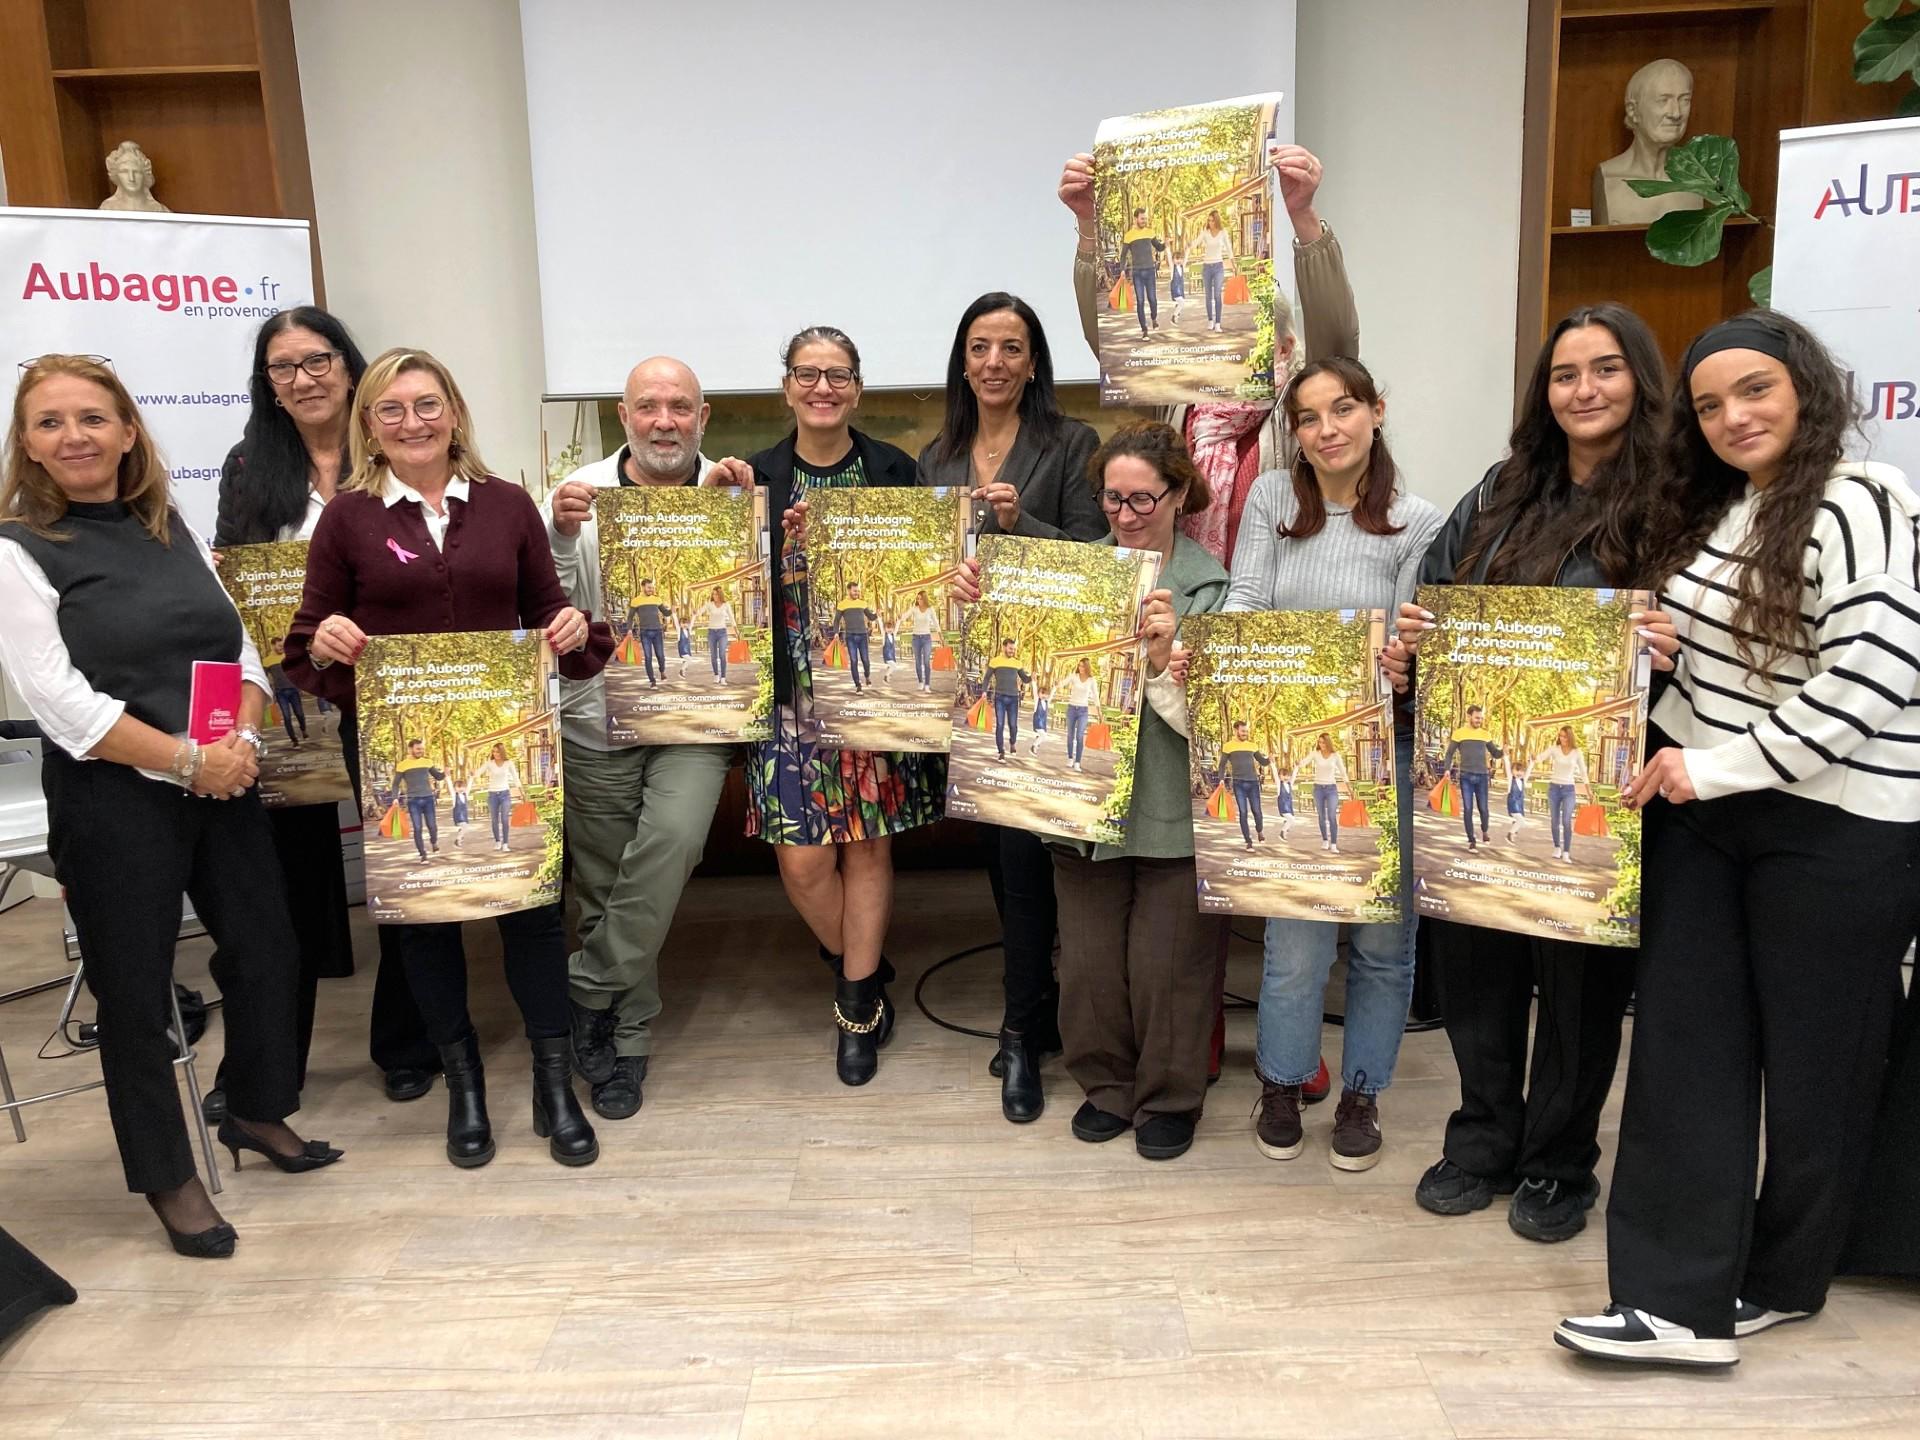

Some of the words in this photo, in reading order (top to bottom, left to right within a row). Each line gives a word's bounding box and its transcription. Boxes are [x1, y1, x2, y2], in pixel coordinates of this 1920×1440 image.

[1122, 148, 1132, 160] je
[1115, 160, 1145, 172] dans
[1147, 158, 1165, 169] ses
[1168, 152, 1229, 166] boutiques
[184, 305, 203, 317] en
[208, 306, 279, 320] provence
[1124, 358, 1143, 367] c'est
[1221, 353, 1241, 361] vivre
[615, 513, 654, 523] J'aime
[823, 515, 860, 525] J'aime
[628, 526, 638, 537] je
[641, 527, 704, 535] consomme
[835, 529, 844, 539] je
[847, 529, 908, 537] consomme
[623, 538, 652, 547] dans
[674, 538, 730, 548] boutiques
[830, 540, 857, 550] dans
[879, 540, 934, 551] boutiques
[236, 571, 278, 582] J'aime
[988, 564, 1028, 576] J'aime
[251, 585, 261, 595] je
[999, 578, 1008, 590] je
[1011, 581, 1078, 596] consomme
[247, 596, 276, 606] dans
[279, 595, 299, 604] ses
[990, 591, 1019, 604] dans
[1022, 596, 1041, 607] ses
[1044, 598, 1105, 614] boutiques
[1441, 618, 1491, 632] J'aime
[1203, 643, 1248, 655] J'aime
[1455, 635, 1469, 649] je
[1472, 636, 1554, 650] consomme
[1218, 656, 1230, 669] je
[1232, 658, 1306, 669] consomme
[1448, 652, 1485, 665] dans
[1487, 656, 1511, 667] ses
[1514, 656, 1589, 672] boutiques
[377, 666, 424, 677] J'aime
[392, 679, 404, 692] je
[407, 677, 482, 688] consomme
[1212, 672, 1245, 683] dans
[1247, 674, 1268, 683] ses
[1270, 673, 1339, 686] boutiques
[386, 693, 420, 705] dans
[423, 694, 444, 703] ses
[447, 689, 512, 703] boutiques
[632, 704, 650, 712] c'est
[976, 776, 996, 785] c'est
[1077, 793, 1097, 802] vivre
[399, 882, 421, 890] c'est
[510, 869, 530, 878] vivre
[1226, 868, 1247, 877] c'est
[1339, 875, 1362, 883] vivre
[1445, 869, 1468, 879] c'est
[1569, 887, 1595, 899] vivre
